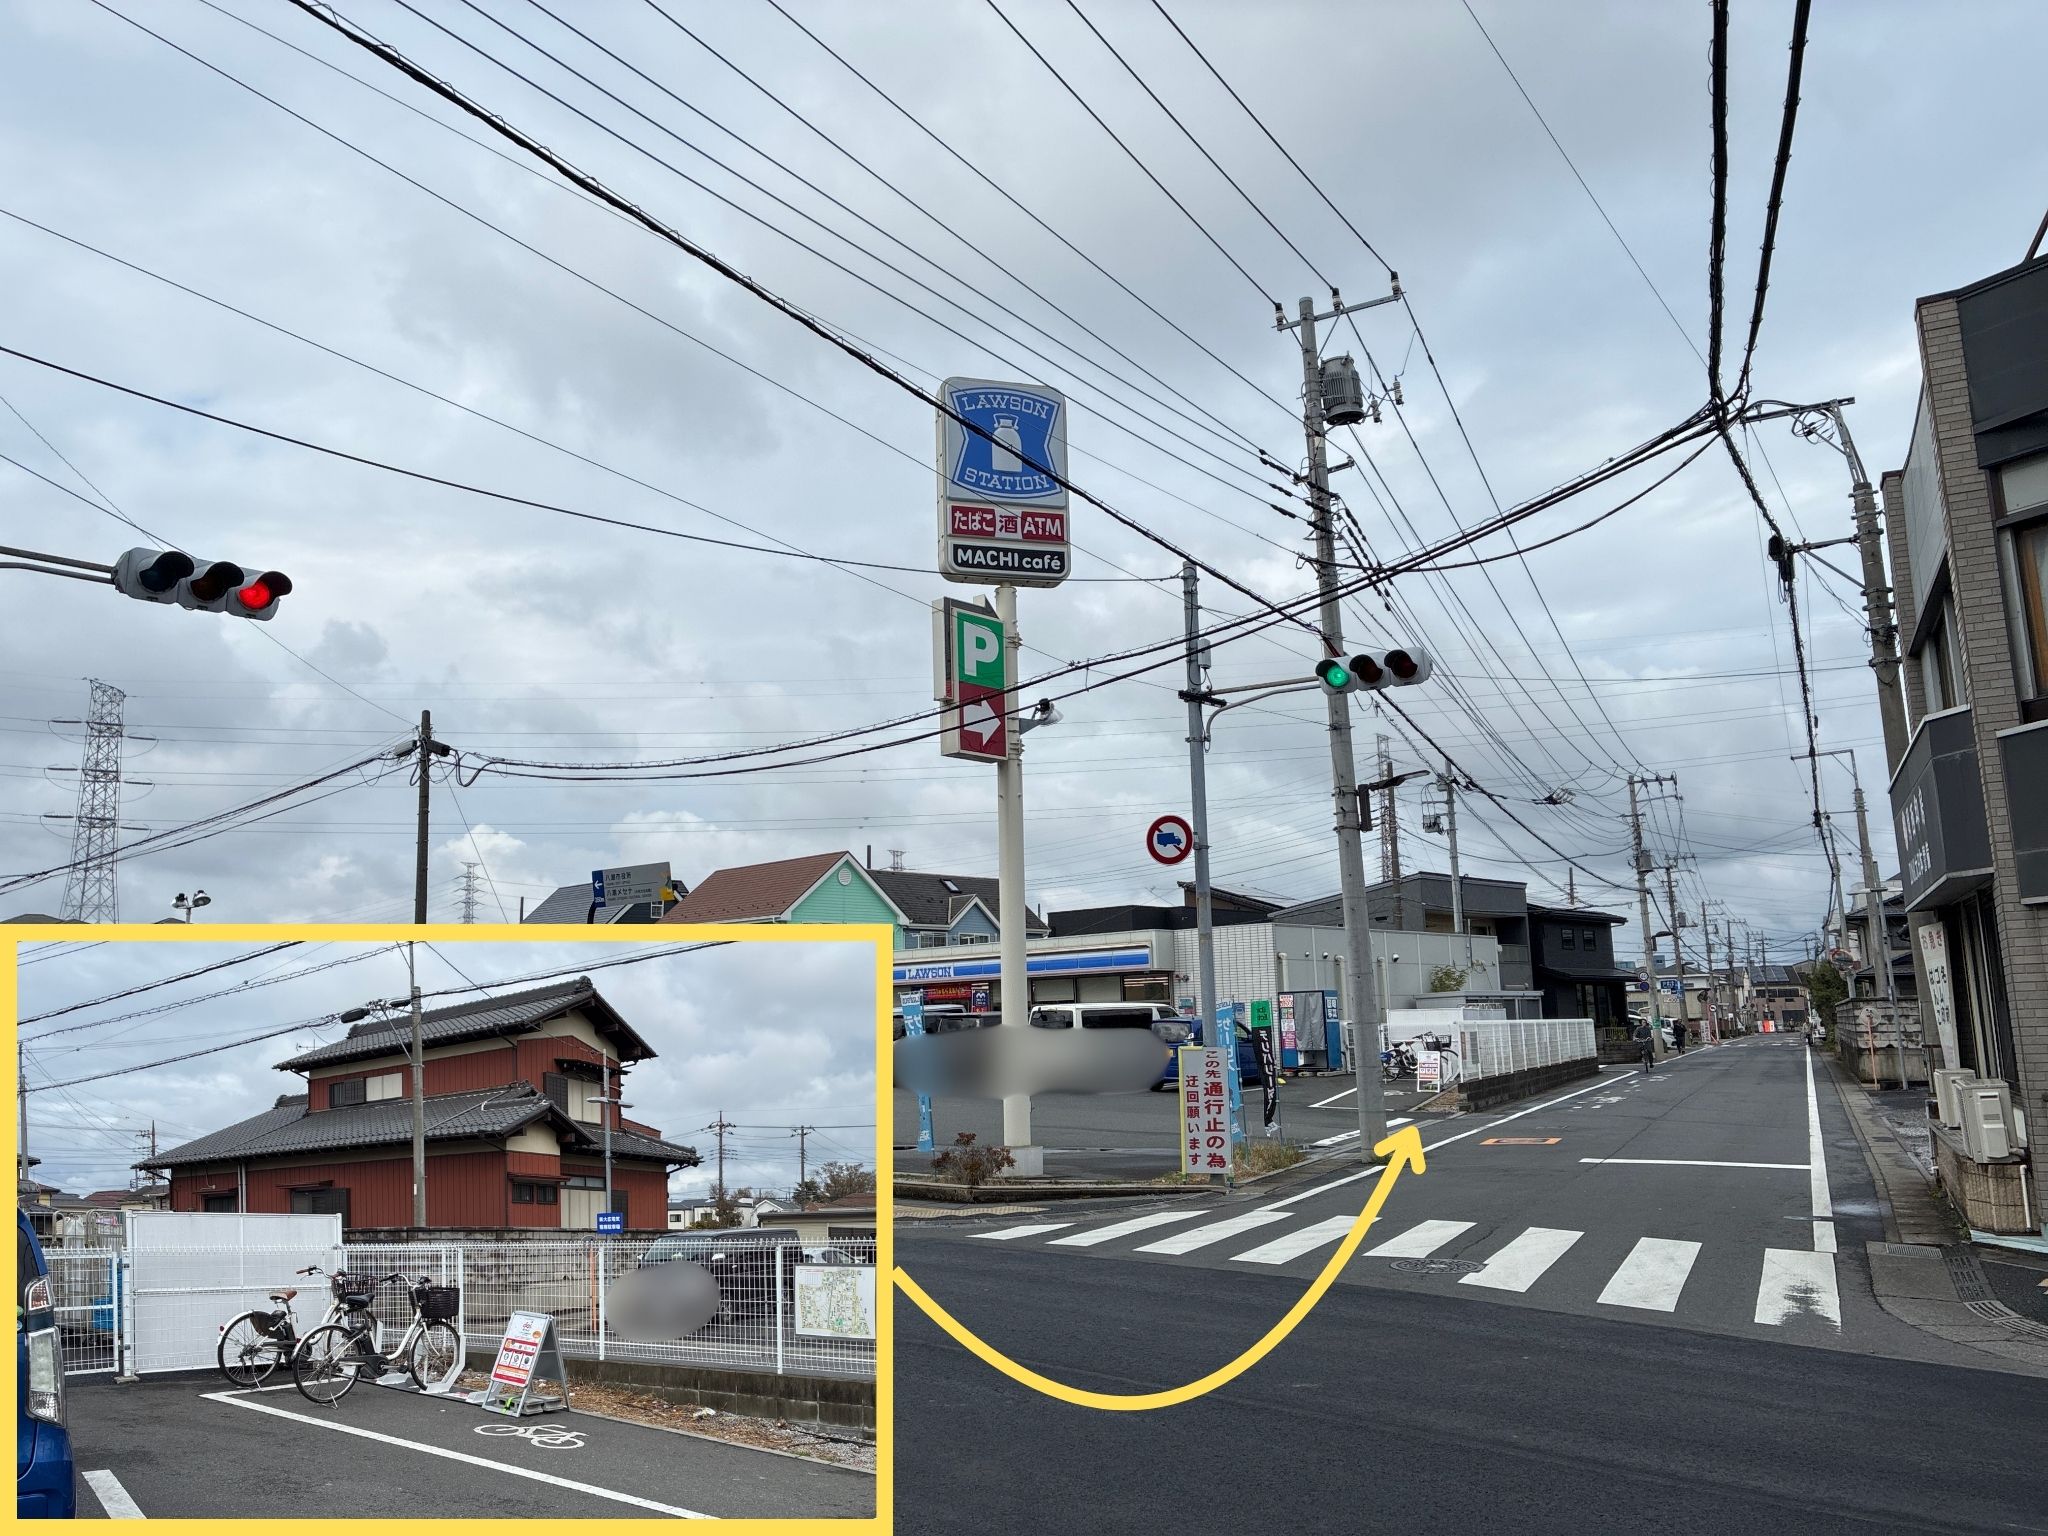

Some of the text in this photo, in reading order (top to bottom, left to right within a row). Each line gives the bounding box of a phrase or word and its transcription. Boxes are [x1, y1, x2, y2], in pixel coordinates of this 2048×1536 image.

[961, 394, 1049, 419] LAWSON
[964, 467, 1050, 490] STATION
[954, 510, 995, 532] たばこ
[998, 515, 1017, 534] 酒
[1023, 516, 1062, 537] ATM
[957, 548, 1061, 570] MACHI café
[963, 621, 999, 676] P
[907, 966, 952, 980] LAWSON
[1185, 1075, 1201, 1165] 迂回願います
[1204, 1051, 1226, 1169] この先通行止の為
